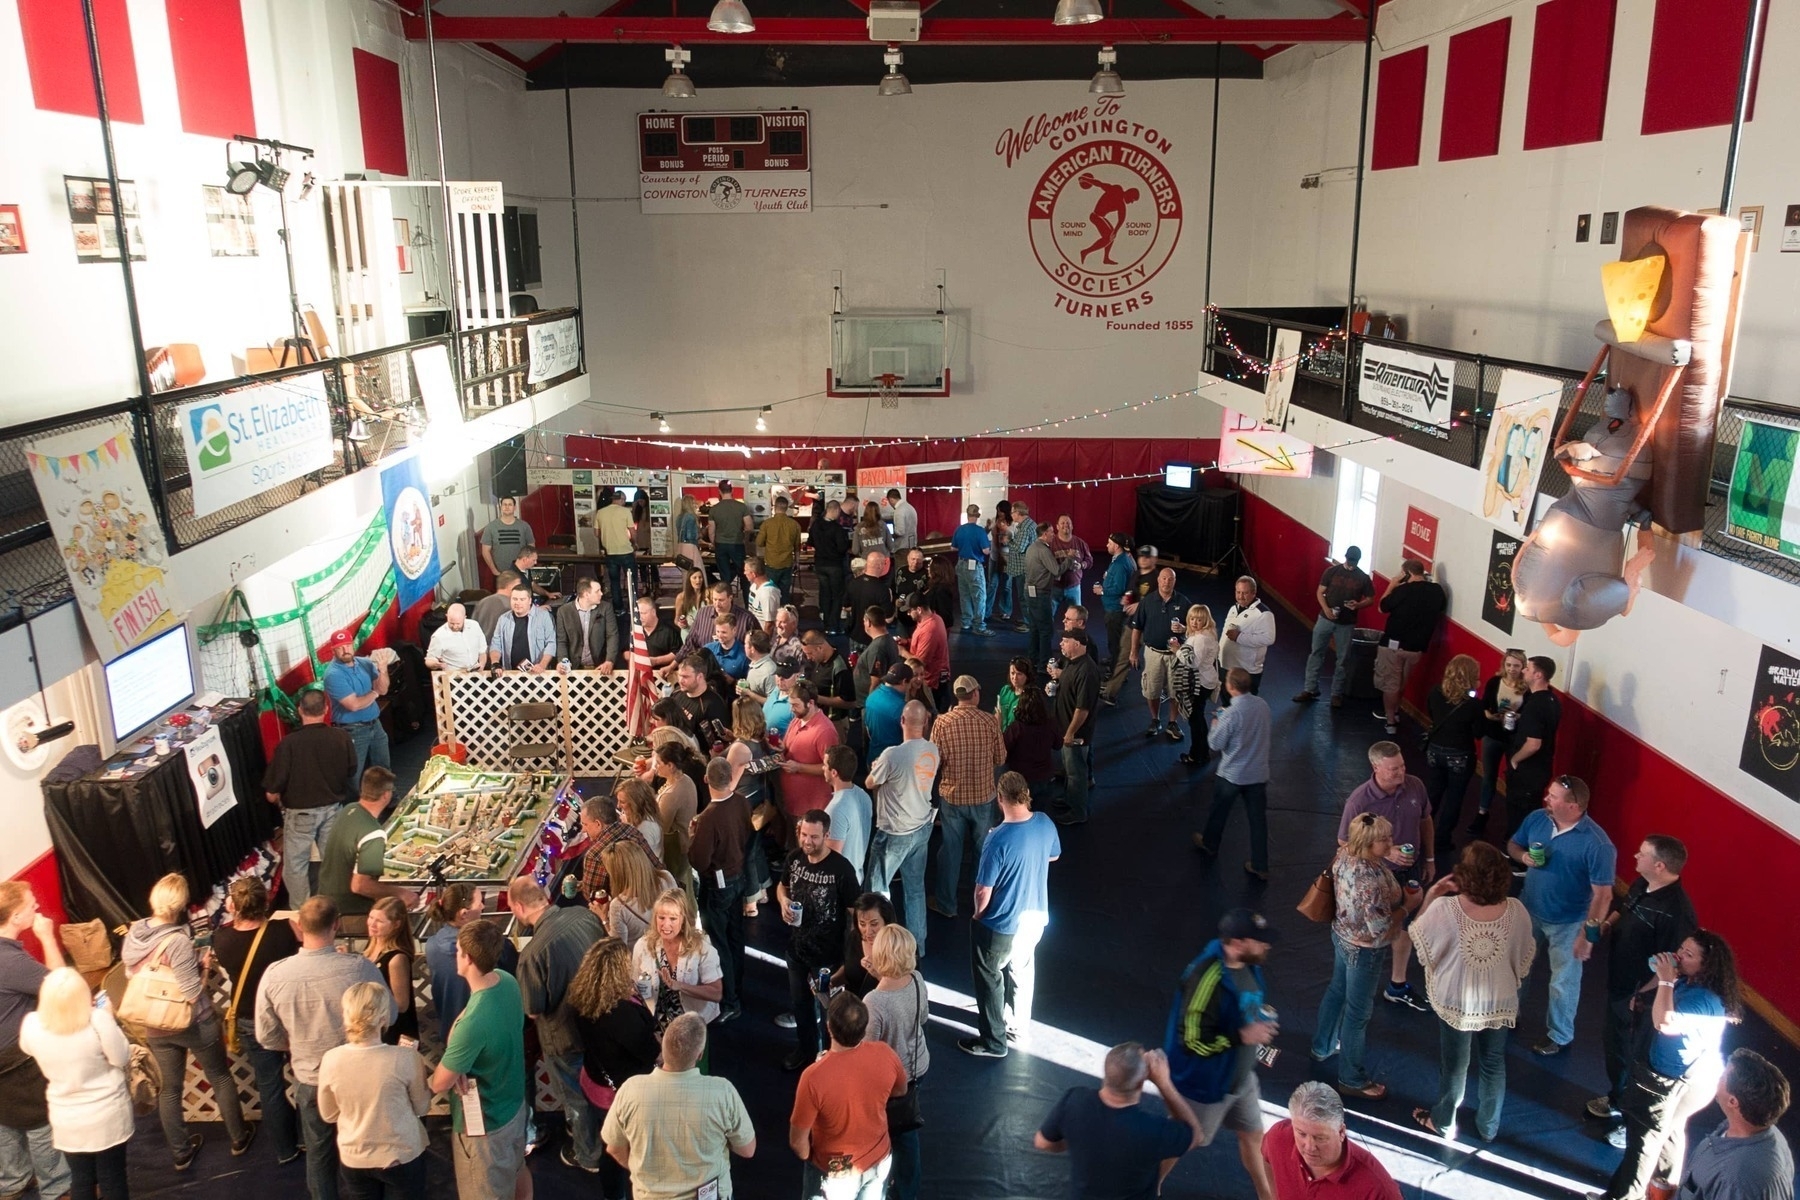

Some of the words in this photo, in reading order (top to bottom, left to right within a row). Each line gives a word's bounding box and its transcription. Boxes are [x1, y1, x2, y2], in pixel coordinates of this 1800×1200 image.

[645, 117, 675, 129] HOME
[765, 116, 805, 127] VISITOR
[995, 106, 1088, 168] Welcome
[1093, 94, 1126, 117] To
[1049, 119, 1173, 154] COVINGTON
[660, 160, 684, 168] BONUS
[702, 154, 730, 162] PERIOD
[764, 159, 789, 167] BONUS
[641, 175, 686, 185] Courtesy
[689, 174, 701, 184] of
[1035, 145, 1113, 214] AMERICAN
[1120, 147, 1176, 215] TURNERS
[643, 190, 708, 199] COVINGTON
[744, 189, 807, 197] TURNERS
[753, 200, 783, 212] Youth
[786, 199, 808, 210] Club
[1055, 262, 1147, 292] SOCIETY
[1053, 290, 1153, 318] TURNERS
[1106, 321, 1160, 330] Founded
[1165, 321, 1193, 330] 1855
[1376, 362, 1425, 394] American
[228, 411, 252, 444] St.
[251, 398, 322, 436] Elizabeth
[601, 477, 634, 485] WINDOW
[861, 470, 901, 487] PAYOUT
[1411, 521, 1431, 542] HOME
[862, 537, 884, 547] PINK
[112, 587, 163, 647] FINISH
[790, 859, 836, 884] Salvation
